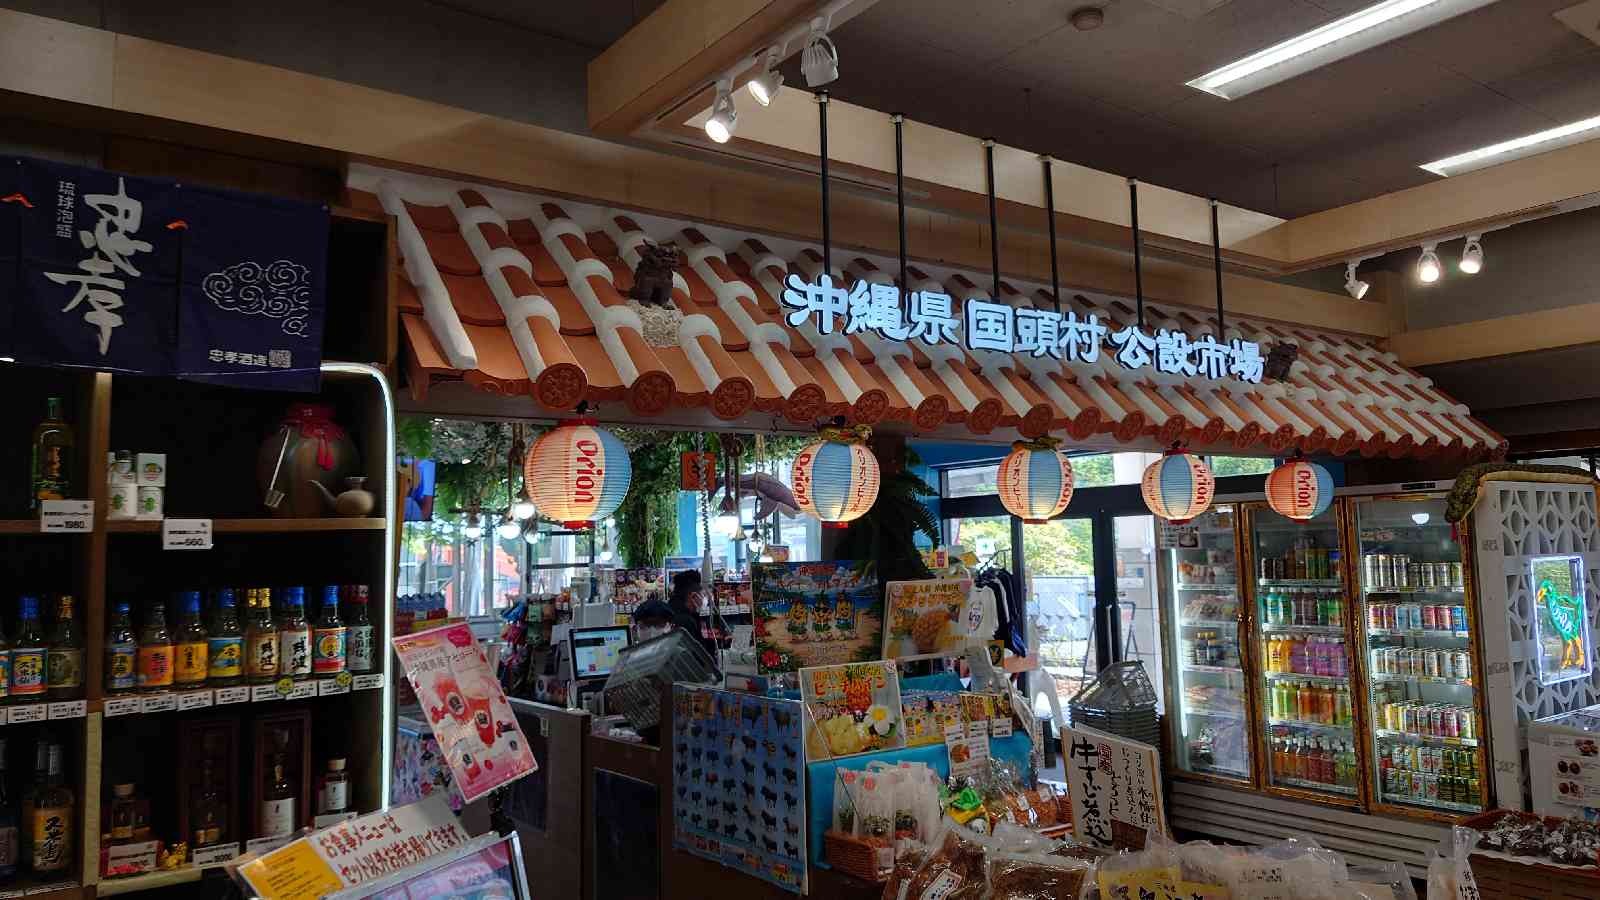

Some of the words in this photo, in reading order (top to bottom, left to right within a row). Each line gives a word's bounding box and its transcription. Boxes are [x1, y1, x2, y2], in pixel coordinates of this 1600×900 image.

[208, 348, 268, 366] 忠孝酒造
[575, 439, 603, 504] Orion
[798, 452, 811, 508] Orion
[1296, 469, 1312, 509] Orion
